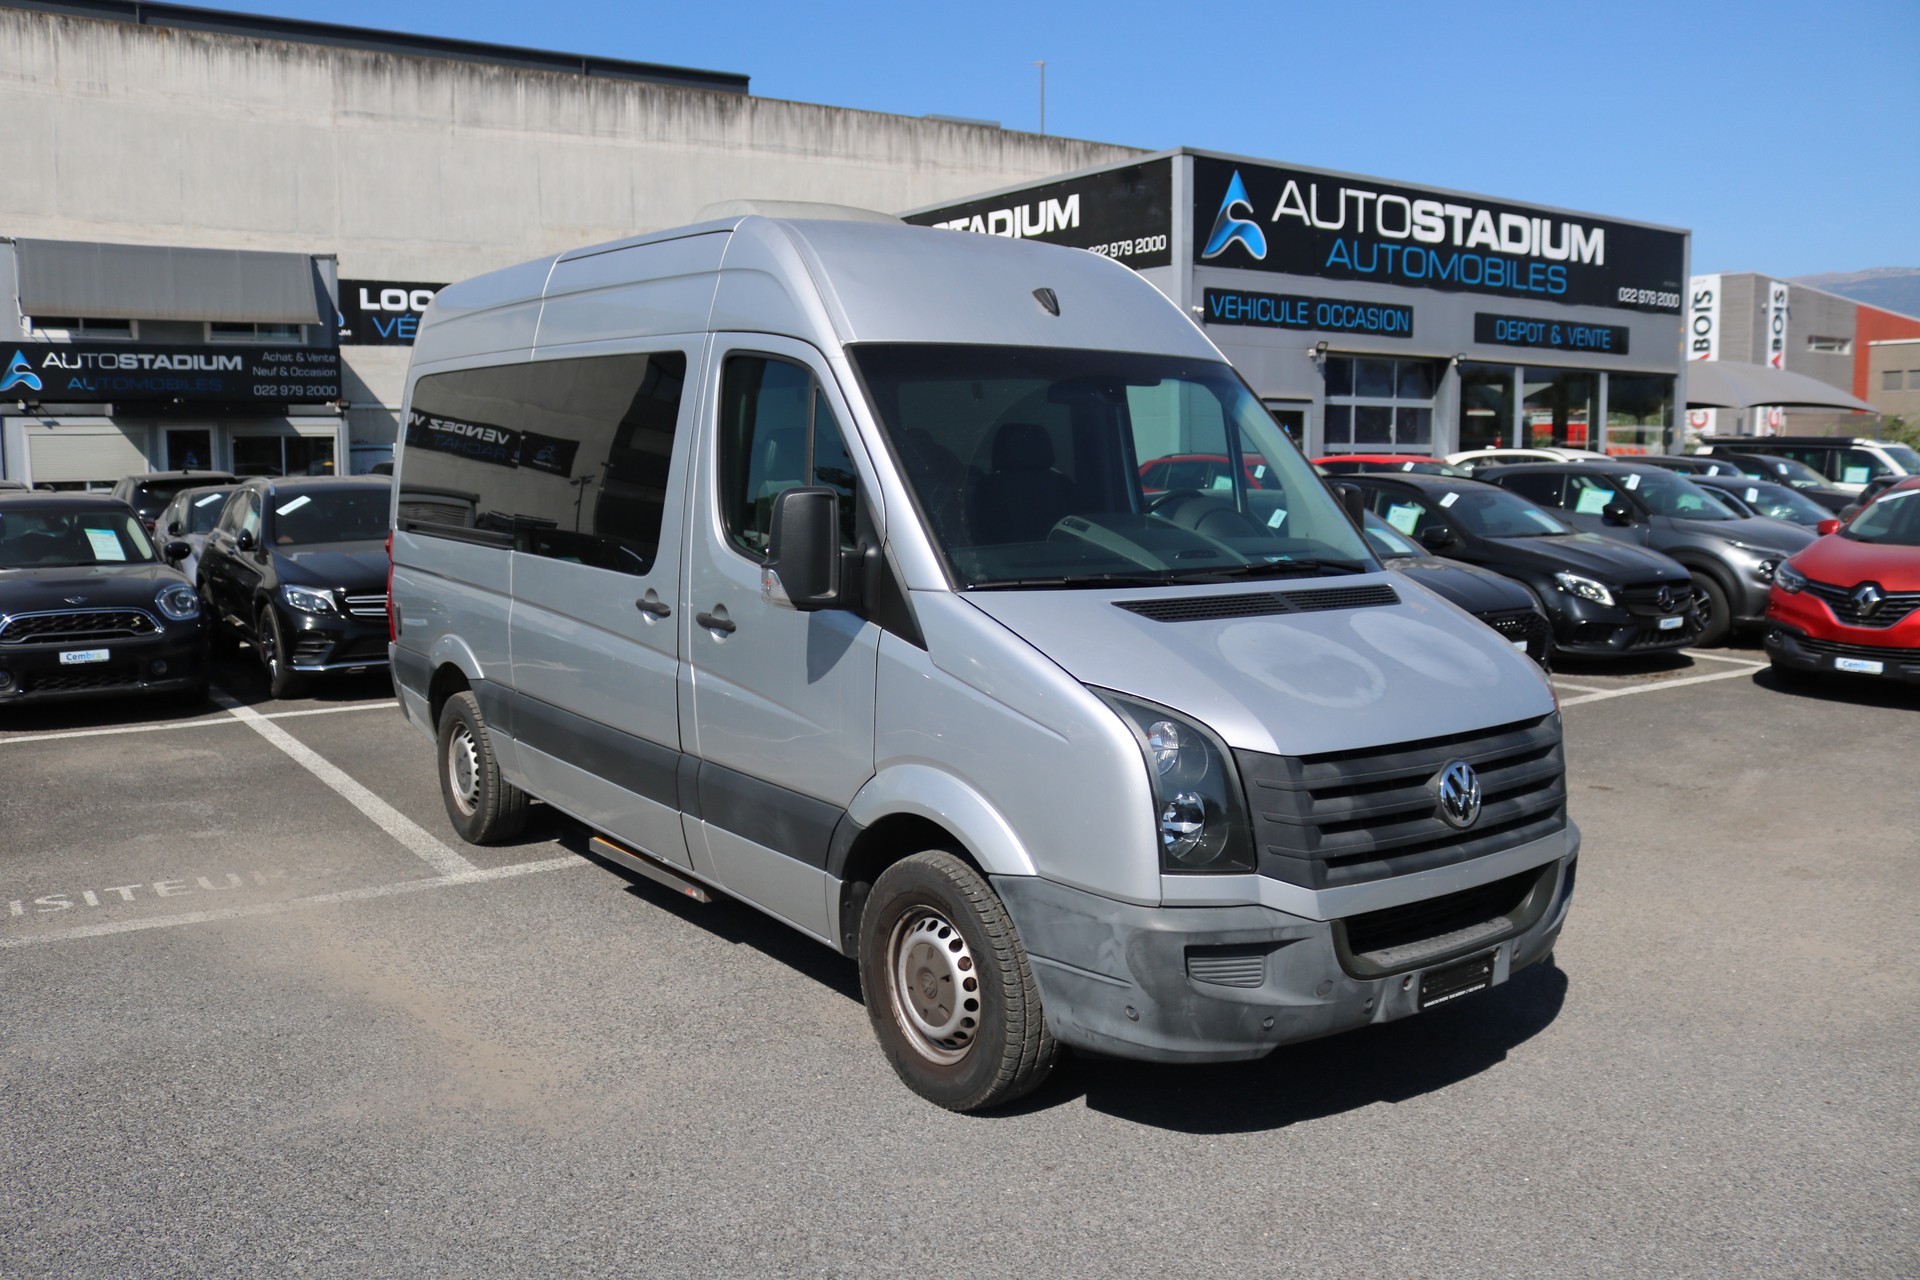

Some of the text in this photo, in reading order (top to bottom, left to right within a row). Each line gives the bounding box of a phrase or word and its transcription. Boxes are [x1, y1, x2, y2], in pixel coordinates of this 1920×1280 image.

[1271, 180, 1605, 265] AUTOSTADIUM
[1110, 239, 1133, 258] 979
[1135, 234, 1167, 254] 2000
[1325, 238, 1568, 294] AUTOMOBILES
[1618, 287, 1680, 308] 022 979 2000
[1210, 294, 1410, 332] VEHICULE OCCASION
[1692, 289, 1713, 352] BOIS
[1771, 289, 1786, 352] BOIS
[1496, 319, 1611, 349] DEPOT & VENTE
[42, 351, 243, 371] AUTOSTADIUM
[262, 351, 336, 363] Achat & Vente
[252, 366, 336, 377] Neuf & Occasion
[67, 376, 224, 392] AUTOMOBILES
[253, 384, 337, 396] 022 979 2000
